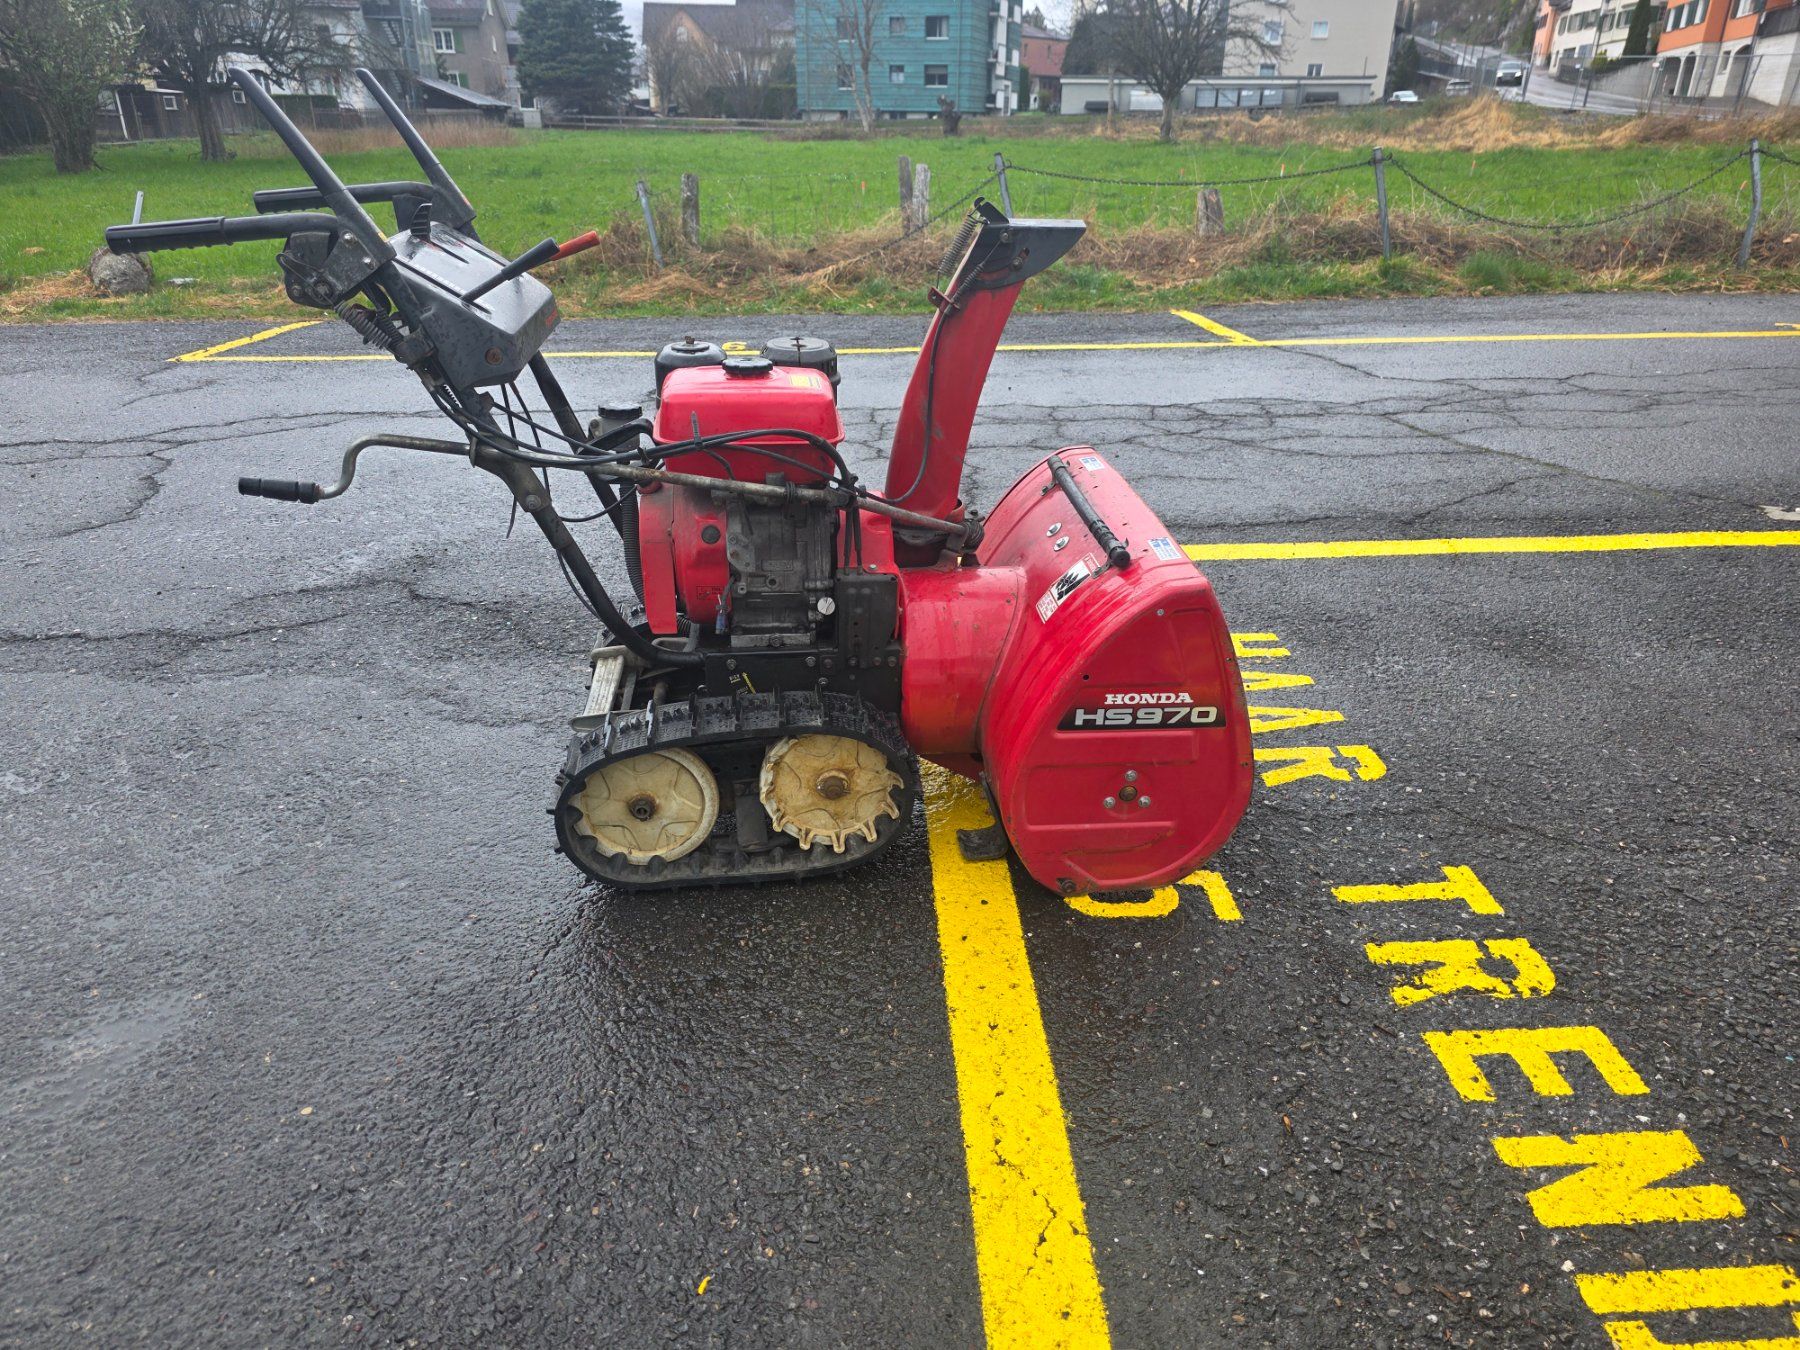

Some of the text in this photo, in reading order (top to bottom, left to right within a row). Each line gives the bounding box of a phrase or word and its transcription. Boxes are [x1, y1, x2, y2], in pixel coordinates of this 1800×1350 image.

[1104, 692, 1194, 705] HONDA
[1074, 706, 1218, 726] HS970
[1331, 865, 1800, 1350] TREND
